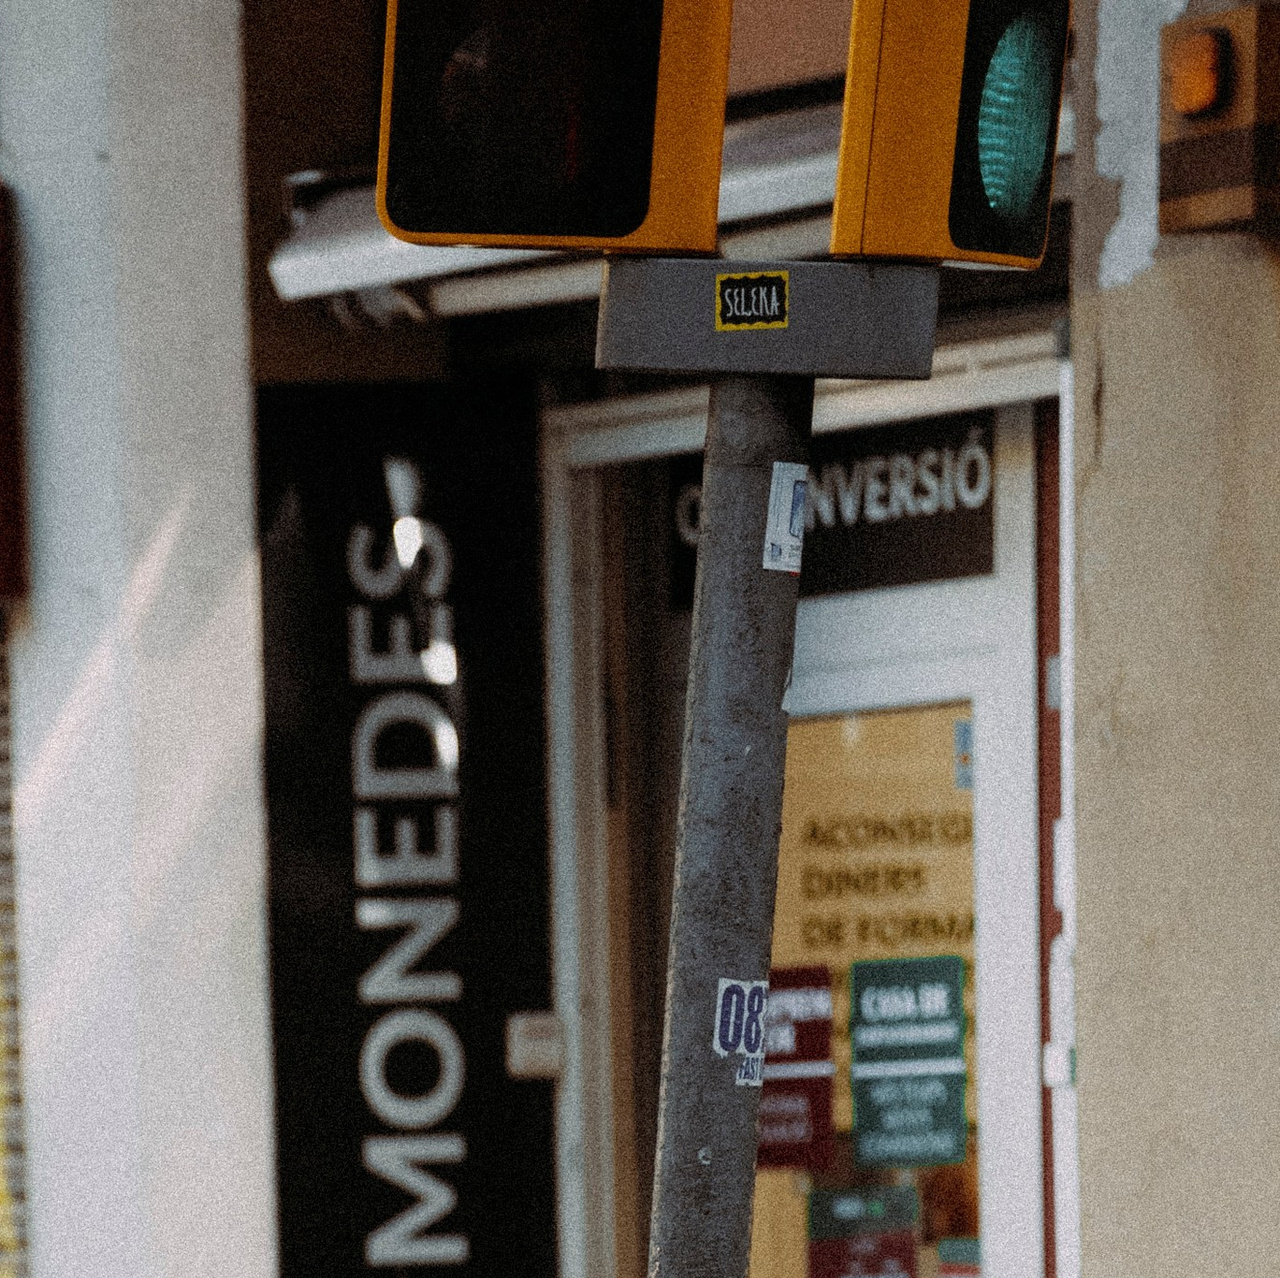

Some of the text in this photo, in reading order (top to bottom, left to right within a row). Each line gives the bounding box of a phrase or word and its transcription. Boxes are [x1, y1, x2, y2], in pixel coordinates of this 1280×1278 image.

[724, 285, 780, 317] SELEKA
[805, 427, 992, 530] NVERSIÓ
[347, 514, 470, 1267] MONEDES
